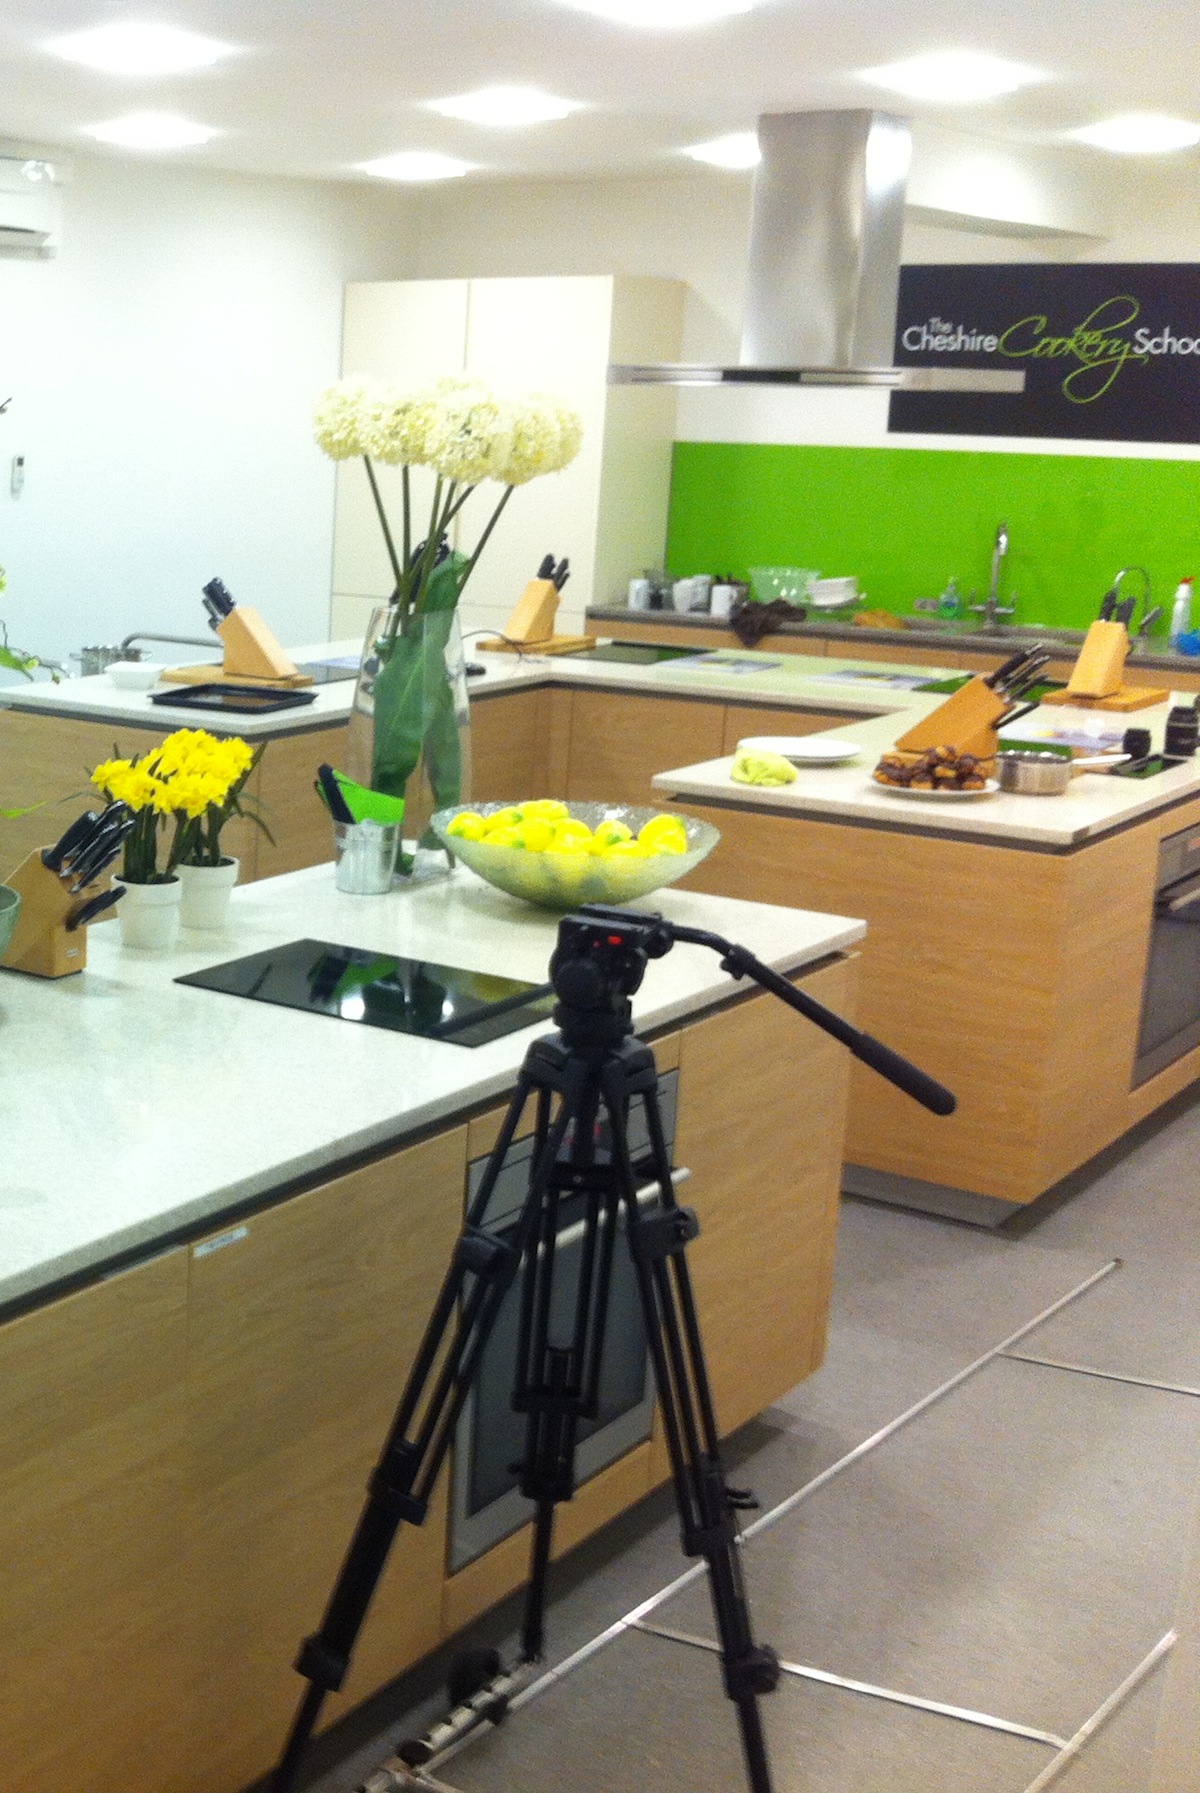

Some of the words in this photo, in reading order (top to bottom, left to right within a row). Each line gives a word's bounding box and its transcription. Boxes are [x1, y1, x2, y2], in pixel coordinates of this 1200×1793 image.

[902, 323, 999, 352] Cheshire
[1000, 294, 1149, 403] Cookery
[929, 316, 954, 334] The
